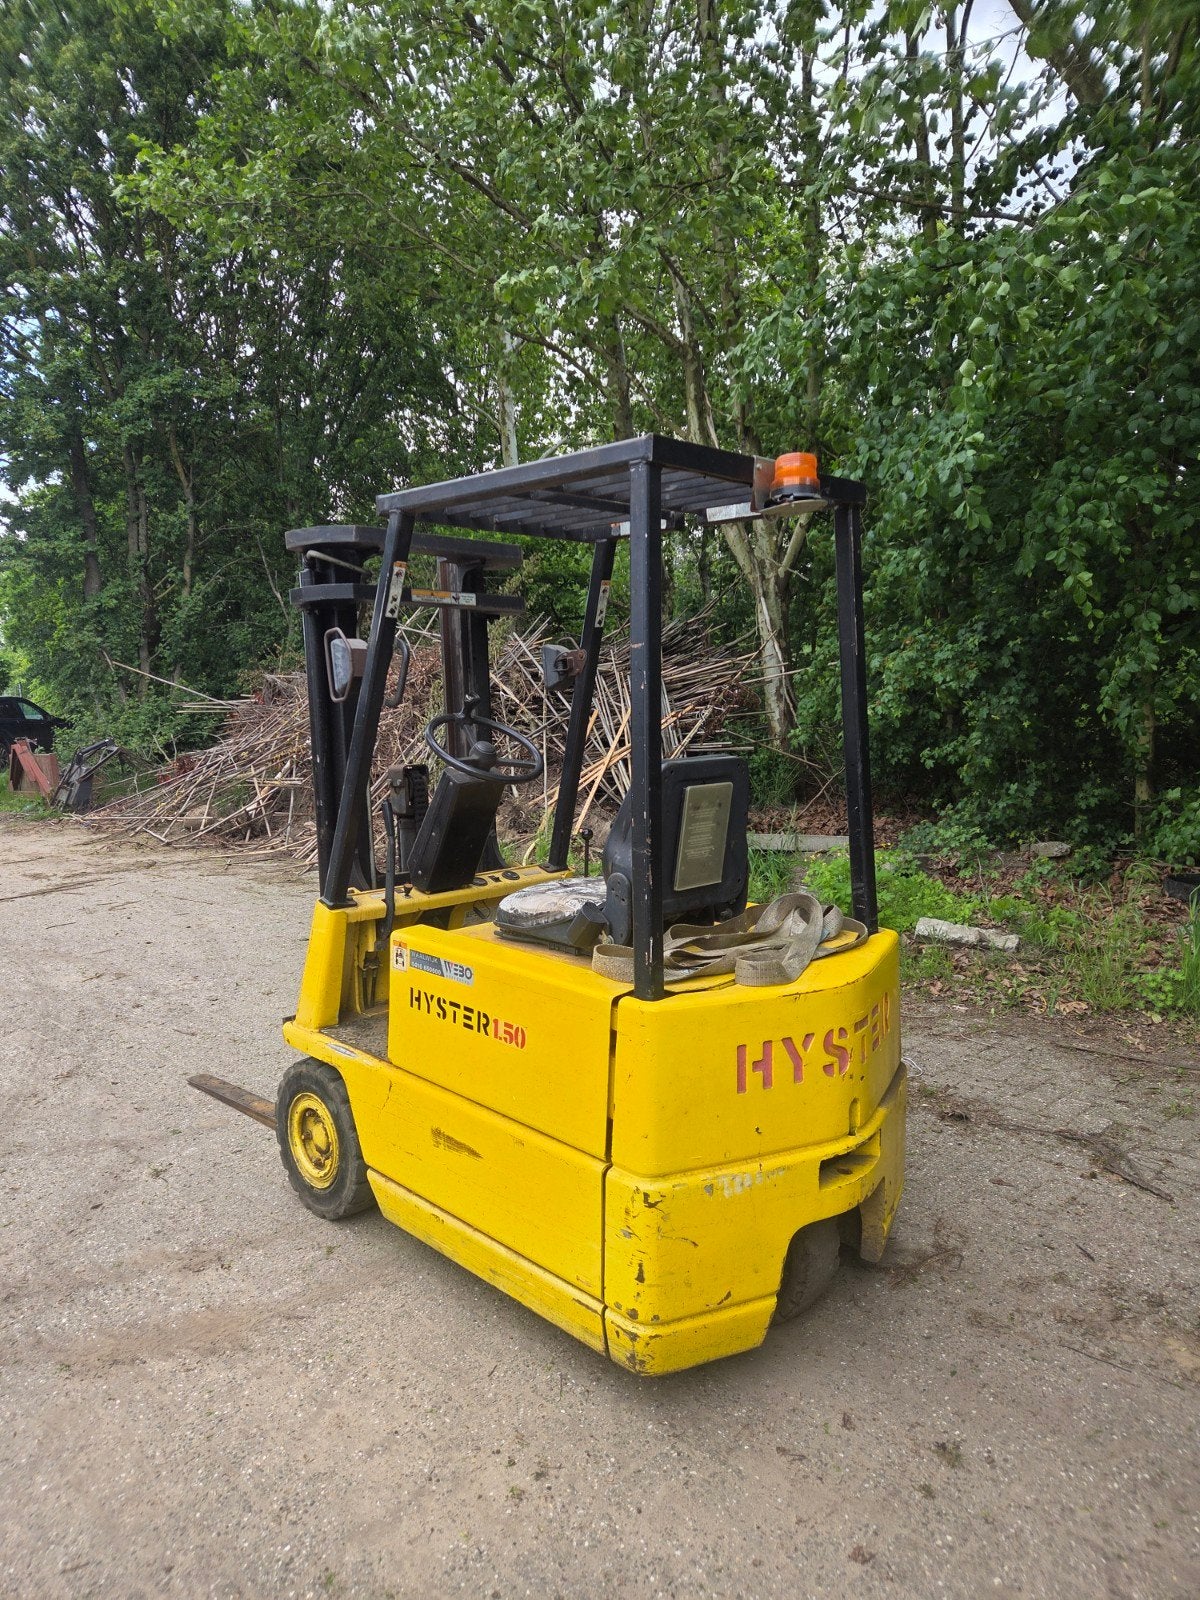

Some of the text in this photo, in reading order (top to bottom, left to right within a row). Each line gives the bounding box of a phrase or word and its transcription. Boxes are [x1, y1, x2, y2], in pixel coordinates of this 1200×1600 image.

[444, 960, 473, 980] WEBO
[409, 986, 526, 1050] HYSTER 1.50
[736, 991, 890, 1094] HYSTER
